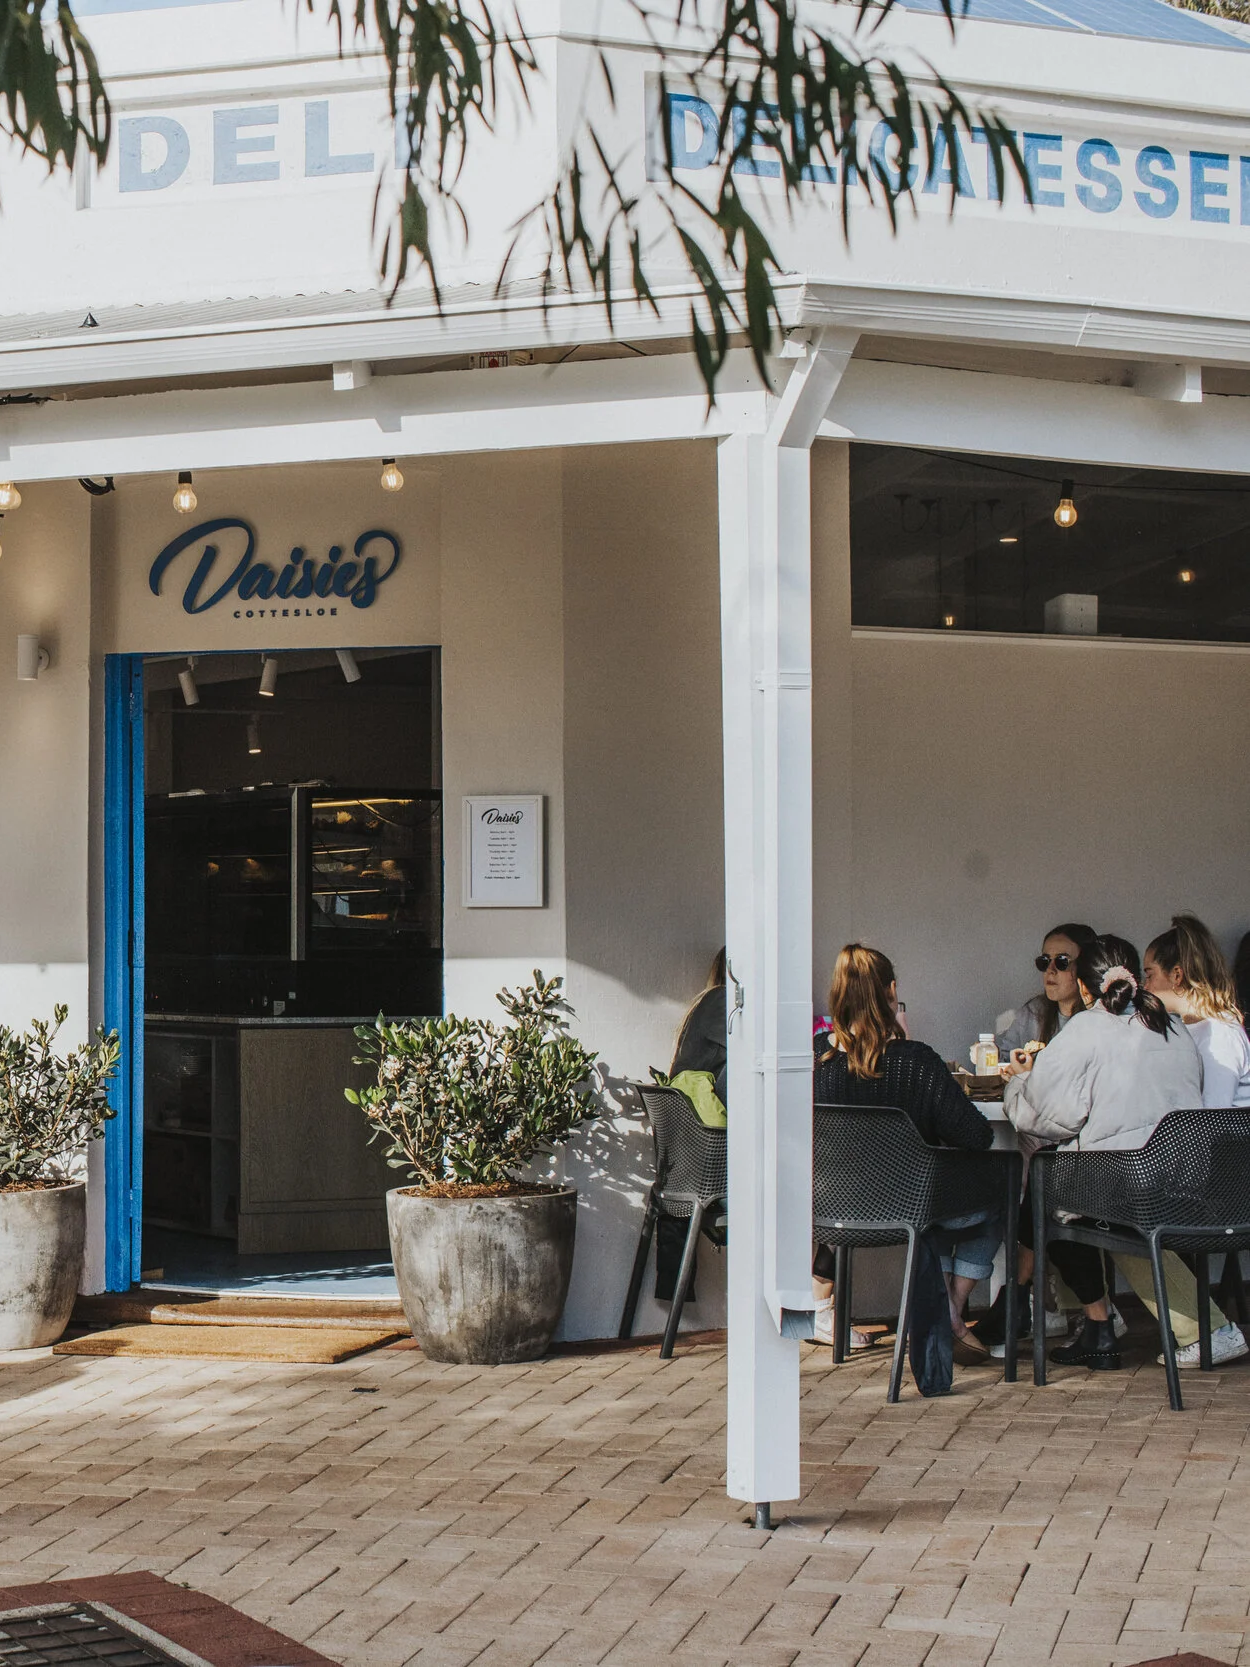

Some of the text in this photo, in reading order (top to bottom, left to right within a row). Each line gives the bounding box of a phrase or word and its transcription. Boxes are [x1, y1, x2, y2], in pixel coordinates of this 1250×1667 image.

[118, 92, 420, 193] DELI
[667, 92, 1250, 227] DELCATESSE
[149, 517, 401, 615] Daisies
[233, 607, 338, 619] COTTESLOE
[481, 808, 524, 825] Daisies
